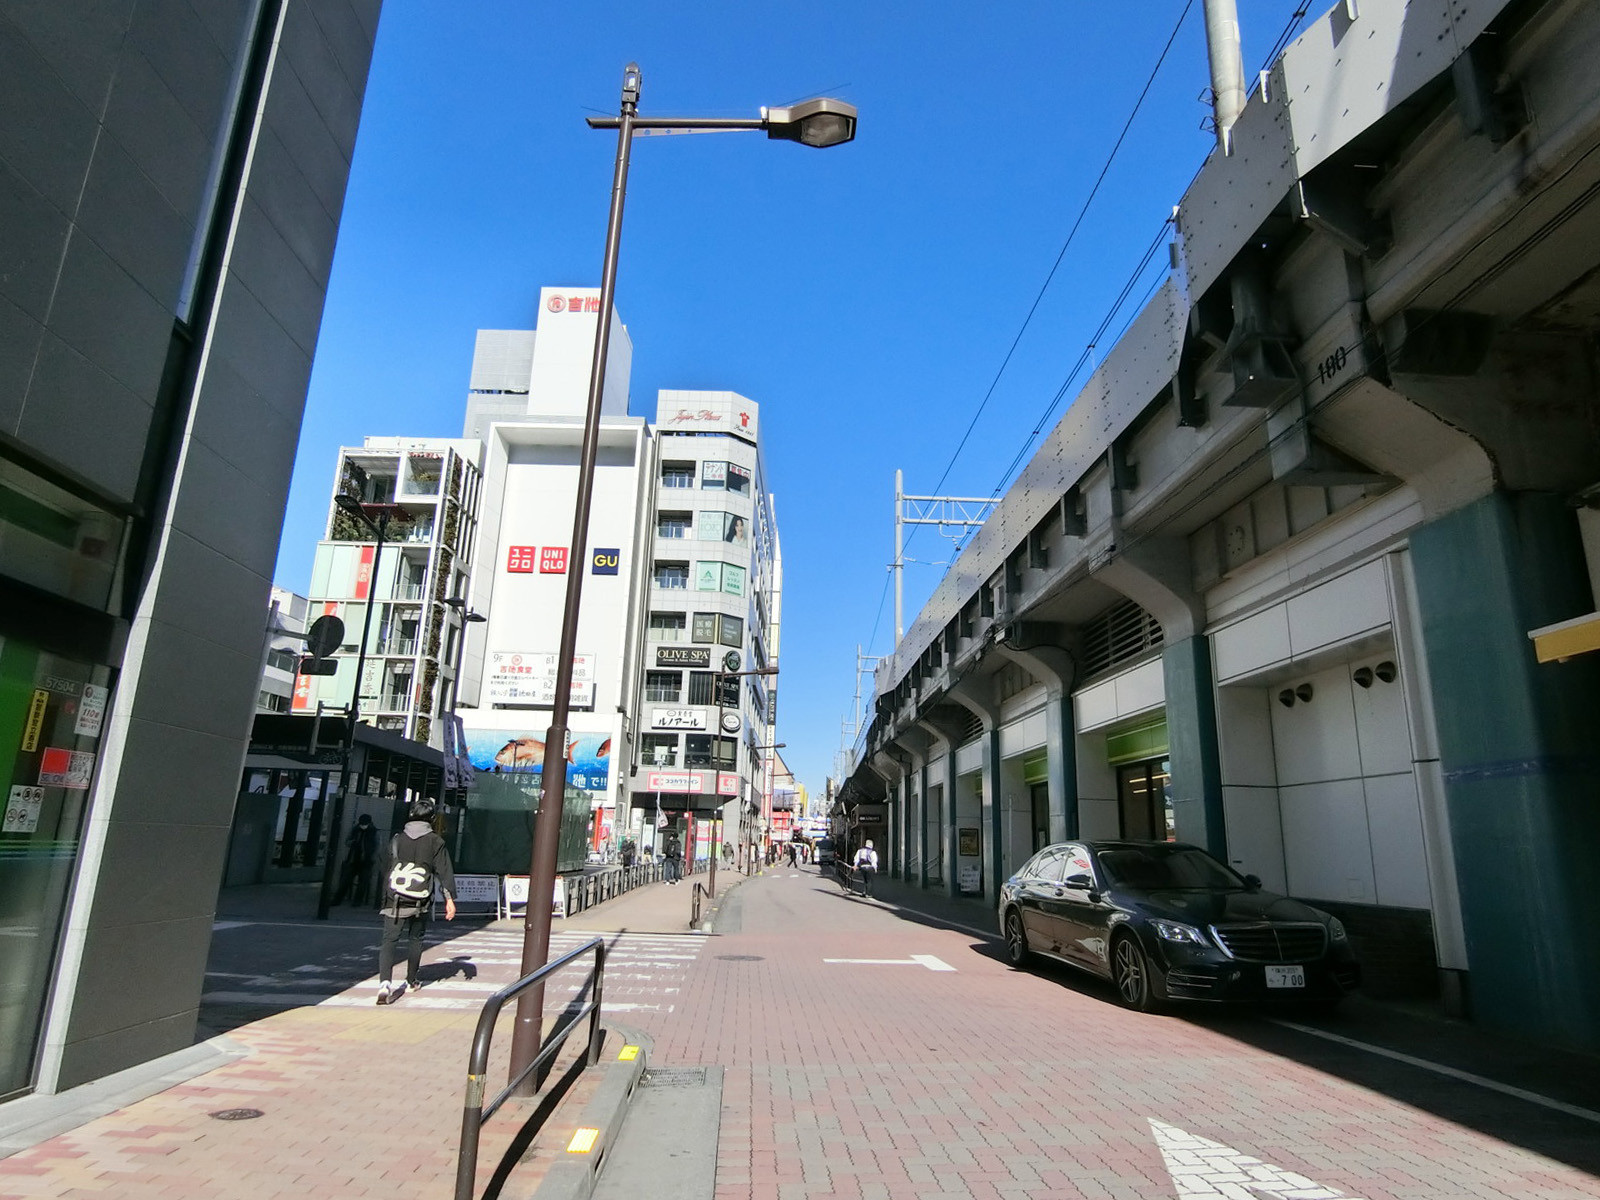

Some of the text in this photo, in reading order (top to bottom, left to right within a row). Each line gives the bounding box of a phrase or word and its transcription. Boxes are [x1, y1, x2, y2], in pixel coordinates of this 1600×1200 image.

[512, 548, 532, 558] ユニ
[543, 550, 564, 559] UNI
[510, 559, 531, 569] クロ
[543, 560, 564, 569] QLO
[594, 554, 618, 568] GU
[657, 649, 709, 660] OLIVE SPA
[658, 717, 700, 727] ルノアール
